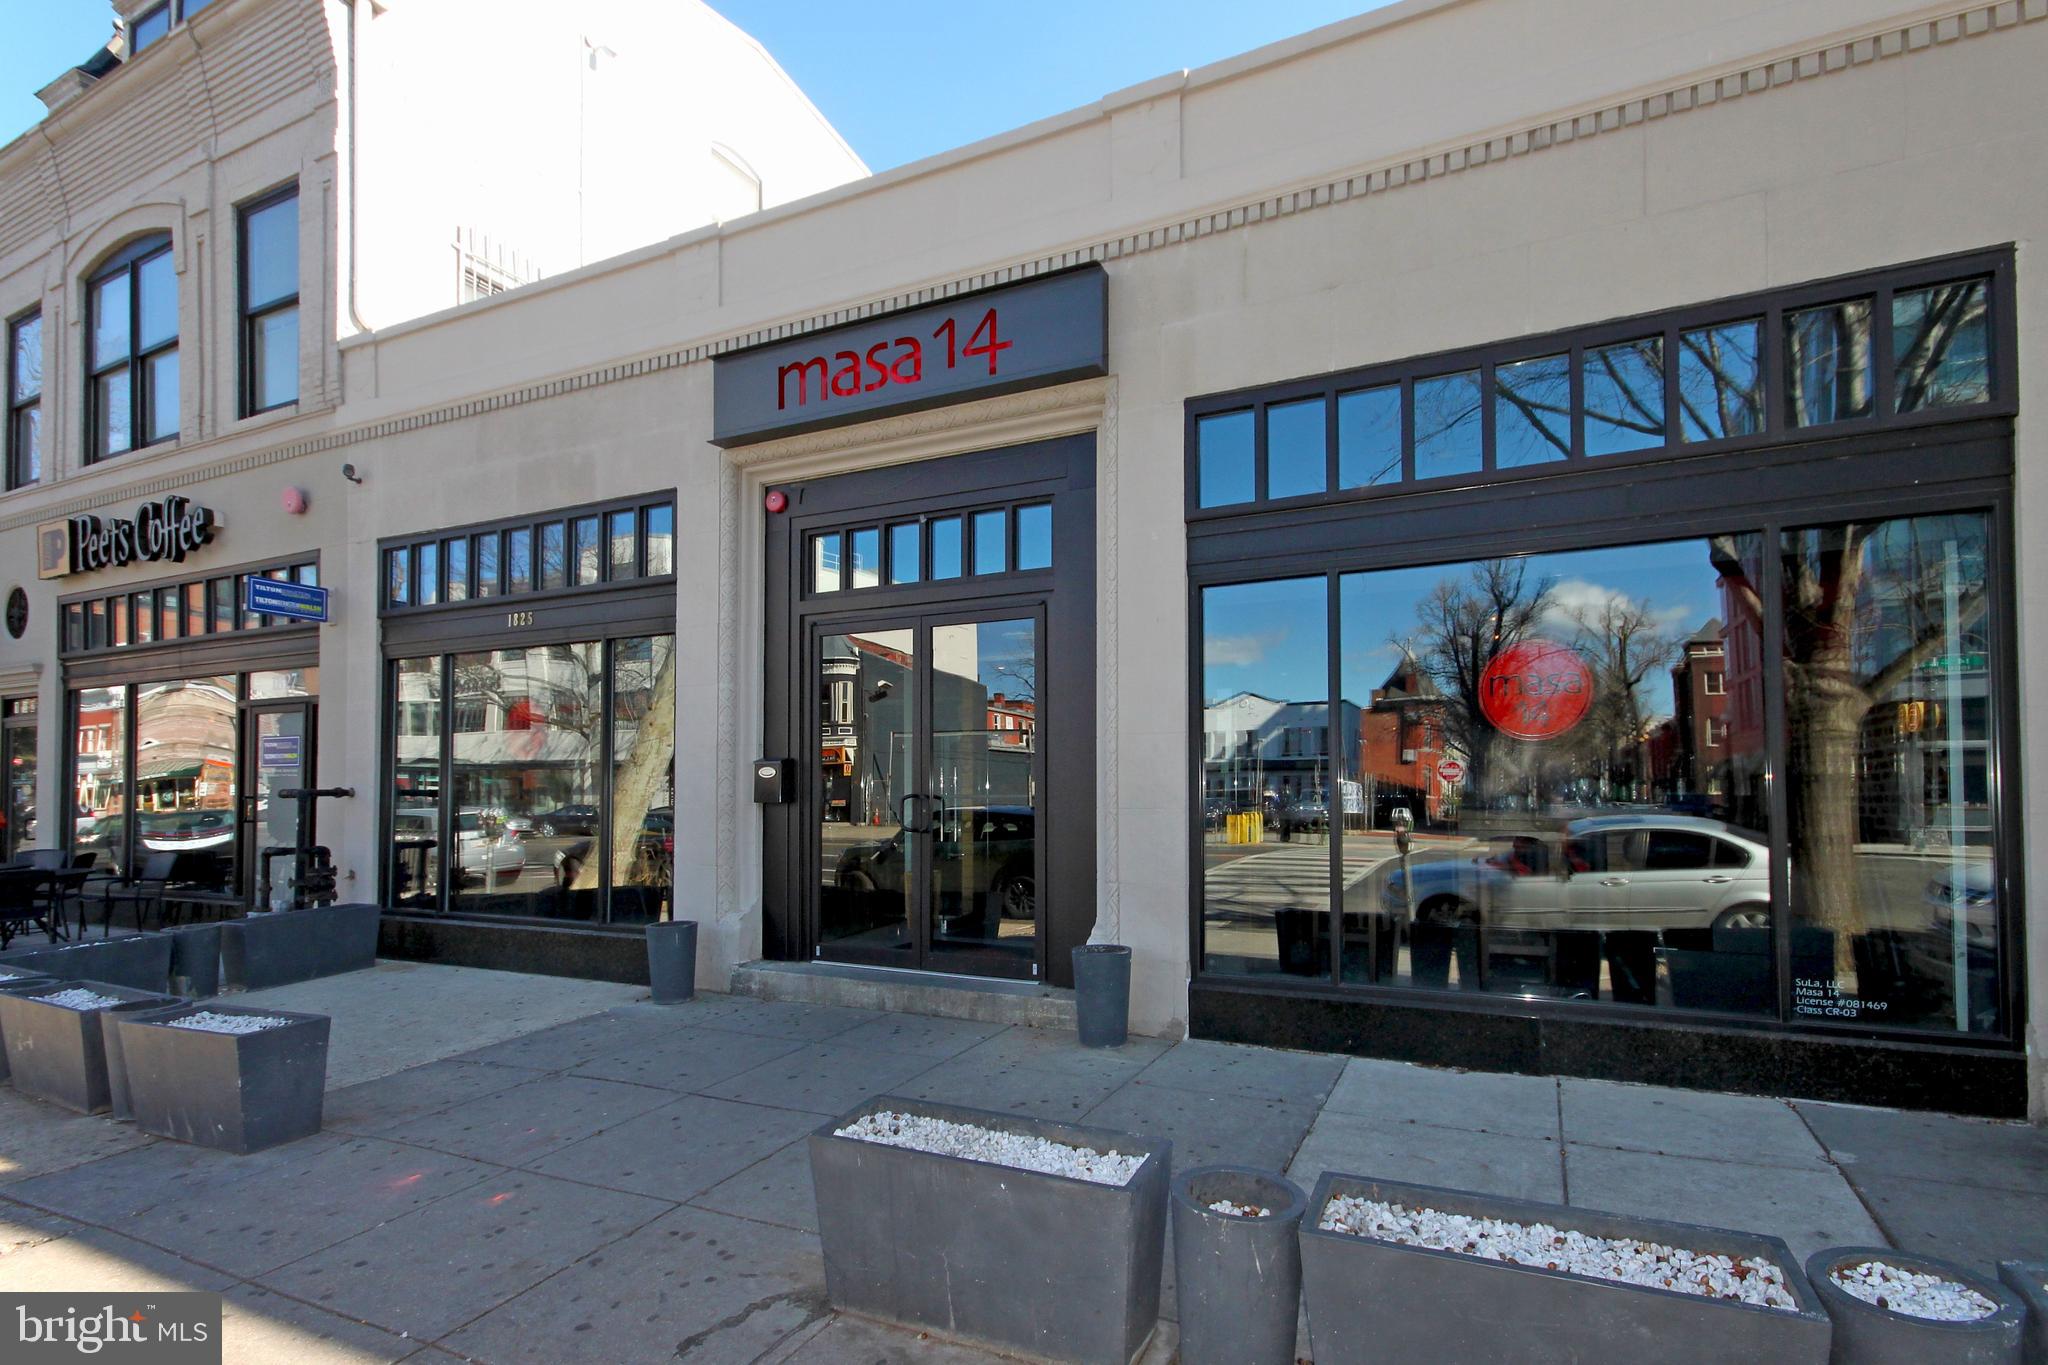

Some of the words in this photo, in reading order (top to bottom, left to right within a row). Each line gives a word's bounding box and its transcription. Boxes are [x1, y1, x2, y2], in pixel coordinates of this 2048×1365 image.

[778, 336, 922, 410] masa
[933, 307, 1013, 376] 14
[134, 494, 205, 563] Coffee
[508, 611, 533, 627] 1825
[1490, 671, 1582, 698] masa
[1826, 979, 1845, 989] LLC
[1796, 987, 1823, 997] Masa
[1828, 989, 1840, 997] 14
[1797, 996, 1834, 1007] License
[1837, 999, 1888, 1010] #081469
[1797, 1005, 1822, 1015] Class
[1825, 1007, 1857, 1017] CR-03
